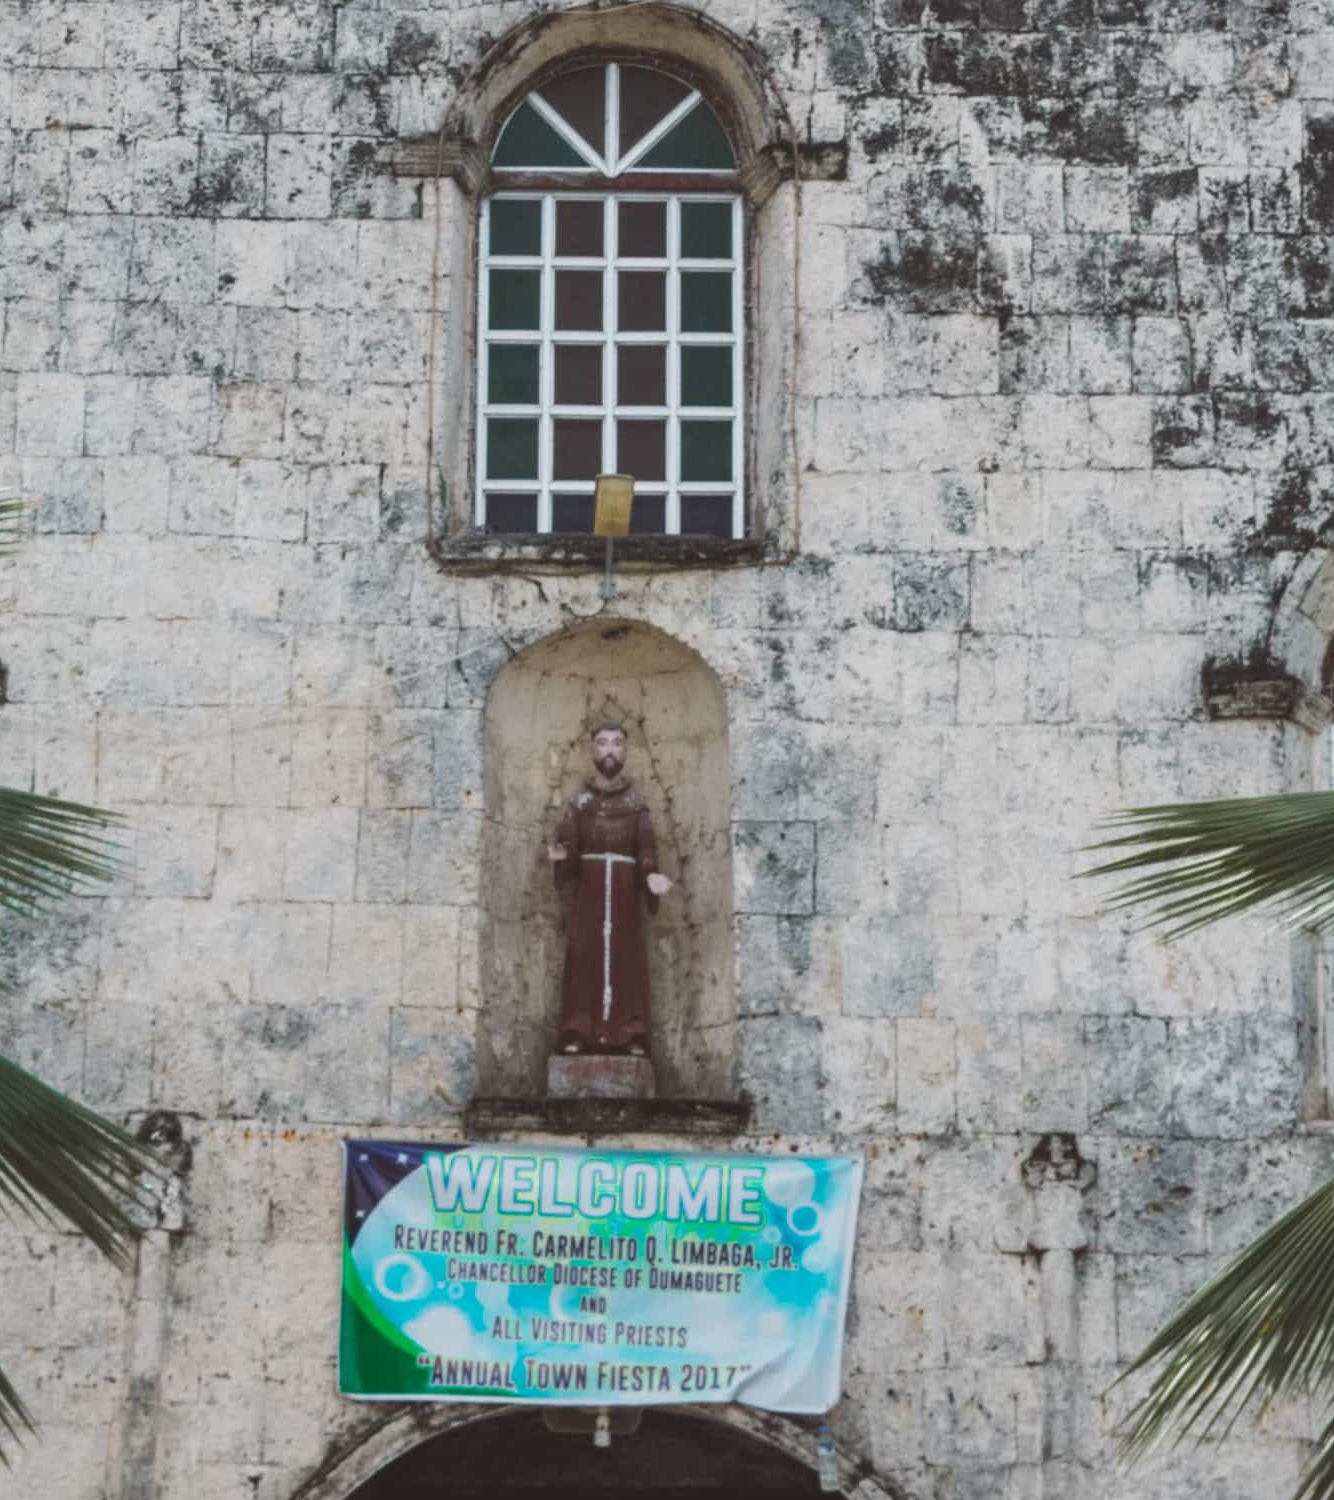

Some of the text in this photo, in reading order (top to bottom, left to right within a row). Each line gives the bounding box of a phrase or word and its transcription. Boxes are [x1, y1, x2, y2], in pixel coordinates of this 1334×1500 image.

[424, 1154, 766, 1225] WELCOME
[394, 1224, 799, 1271] REVEREND FR. CARMELITO Q. LIMBAGA, JR.
[447, 1258, 742, 1293] CHANCELLOR DIOCESE OF DUMAGUETE
[580, 1296, 607, 1315] AND
[492, 1316, 688, 1348] ALL VISITING PRIESTS
[526, 1359, 587, 1390] TOWN
[597, 1361, 671, 1392] FIESTA
